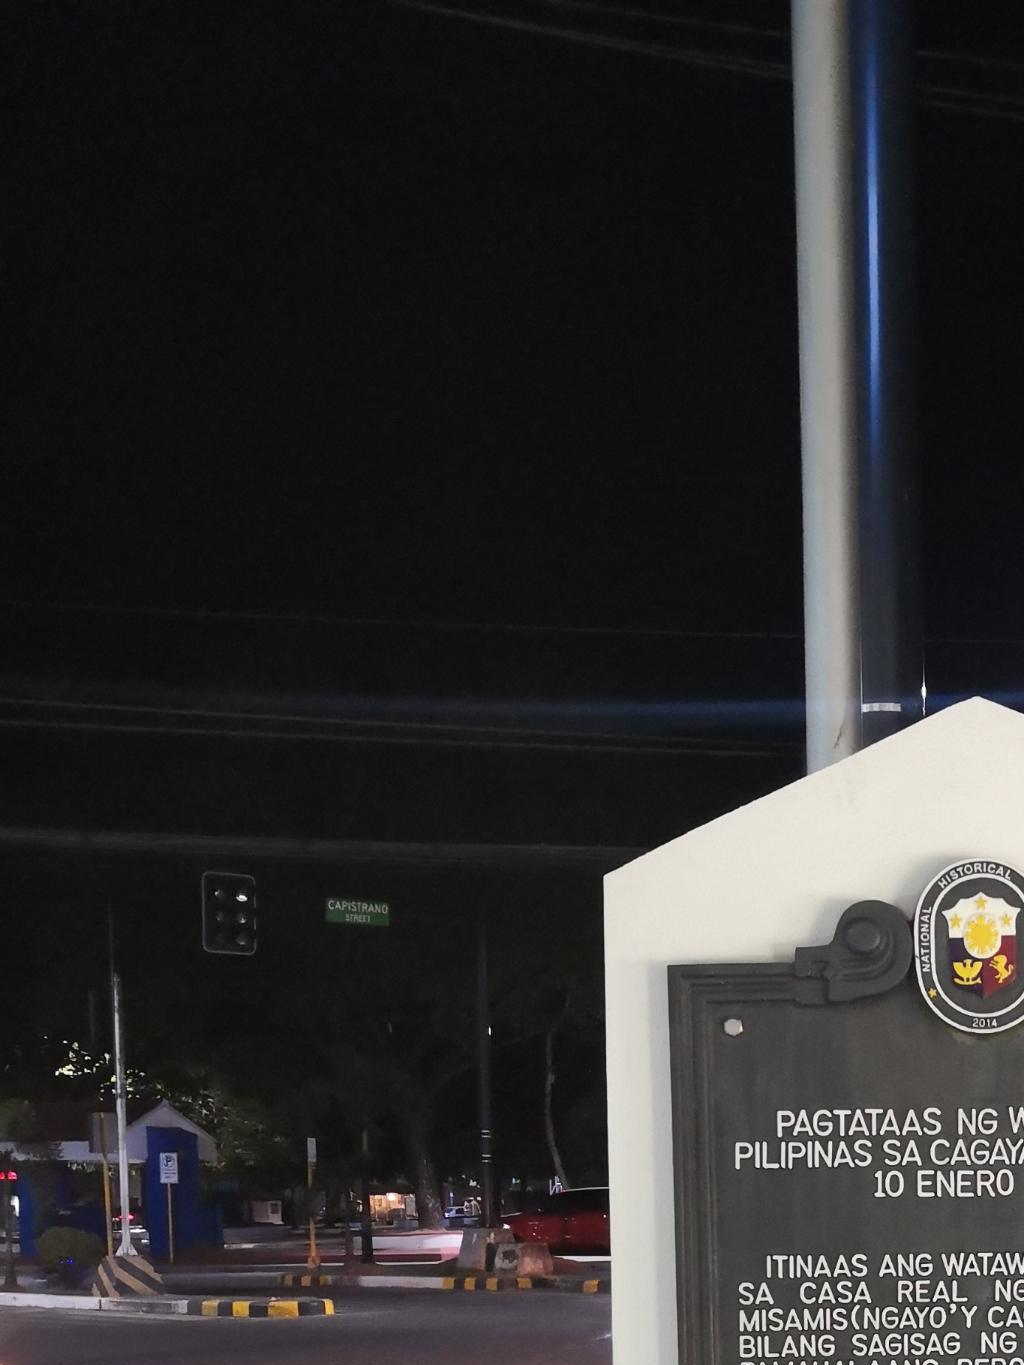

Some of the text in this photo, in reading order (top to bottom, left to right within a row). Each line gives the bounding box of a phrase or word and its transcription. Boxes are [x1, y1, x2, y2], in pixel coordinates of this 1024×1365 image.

[328, 900, 388, 914] CAPISTRANO
[919, 906, 932, 972] NATIONAL
[937, 863, 1012, 888] HISTORICAL
[972, 1018, 997, 1028] 2014
[776, 1107, 942, 1138] PAGTATAAS
[957, 1107, 999, 1136] NG
[734, 1139, 873, 1170] PILIPINAS
[882, 1138, 923, 1167] SA
[873, 1170, 905, 1198] 10
[916, 1168, 1015, 1198] ENERO
[766, 1253, 868, 1279] ITINAAS
[878, 1253, 934, 1278] ANG
[738, 1282, 775, 1306] SA
[799, 1280, 872, 1305] CASA
[897, 1279, 969, 1304] REAL
[739, 1334, 836, 1359] BILANG
[851, 1331, 961, 1357] SAGISAG
[980, 1331, 1018, 1354] NG
